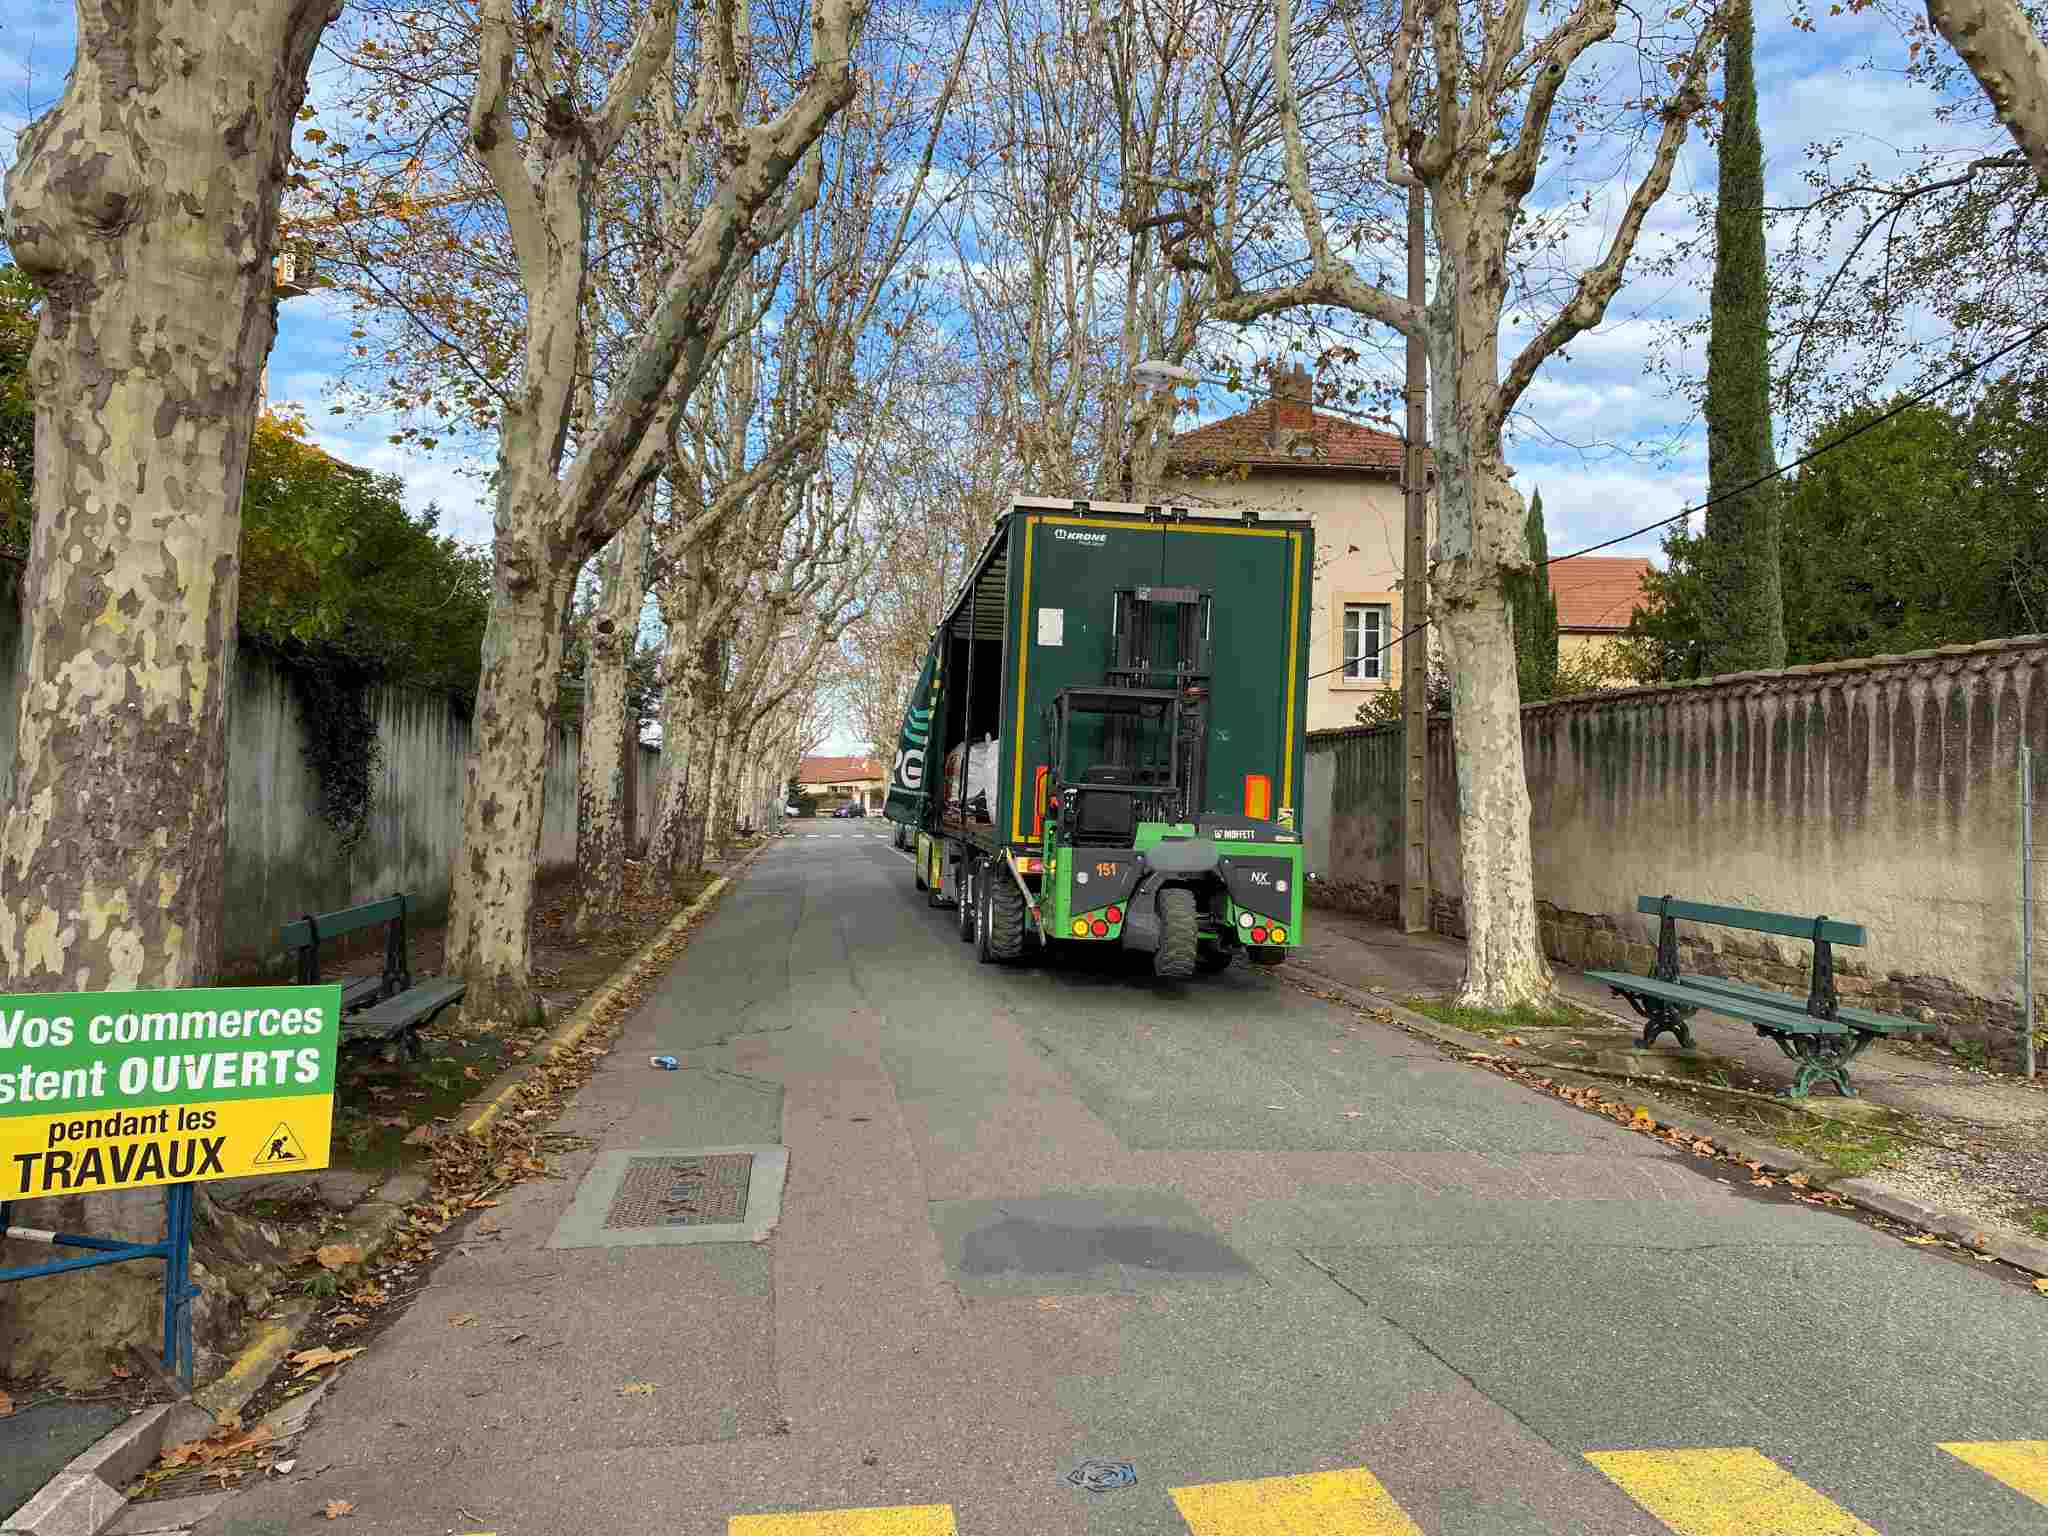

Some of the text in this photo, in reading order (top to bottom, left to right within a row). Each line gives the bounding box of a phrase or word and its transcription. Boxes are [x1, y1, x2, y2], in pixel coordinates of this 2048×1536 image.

[1066, 532, 1108, 541] KRONE
[1223, 829, 1255, 841] MOFFETT
[1095, 863, 1116, 878] 151
[1250, 872, 1269, 882] NX
[0, 1007, 323, 1049] Vos commerces
[0, 1048, 321, 1103] stent OUVERTS
[48, 1107, 217, 1148] pendant les
[13, 1136, 226, 1194] TRAVAUX
